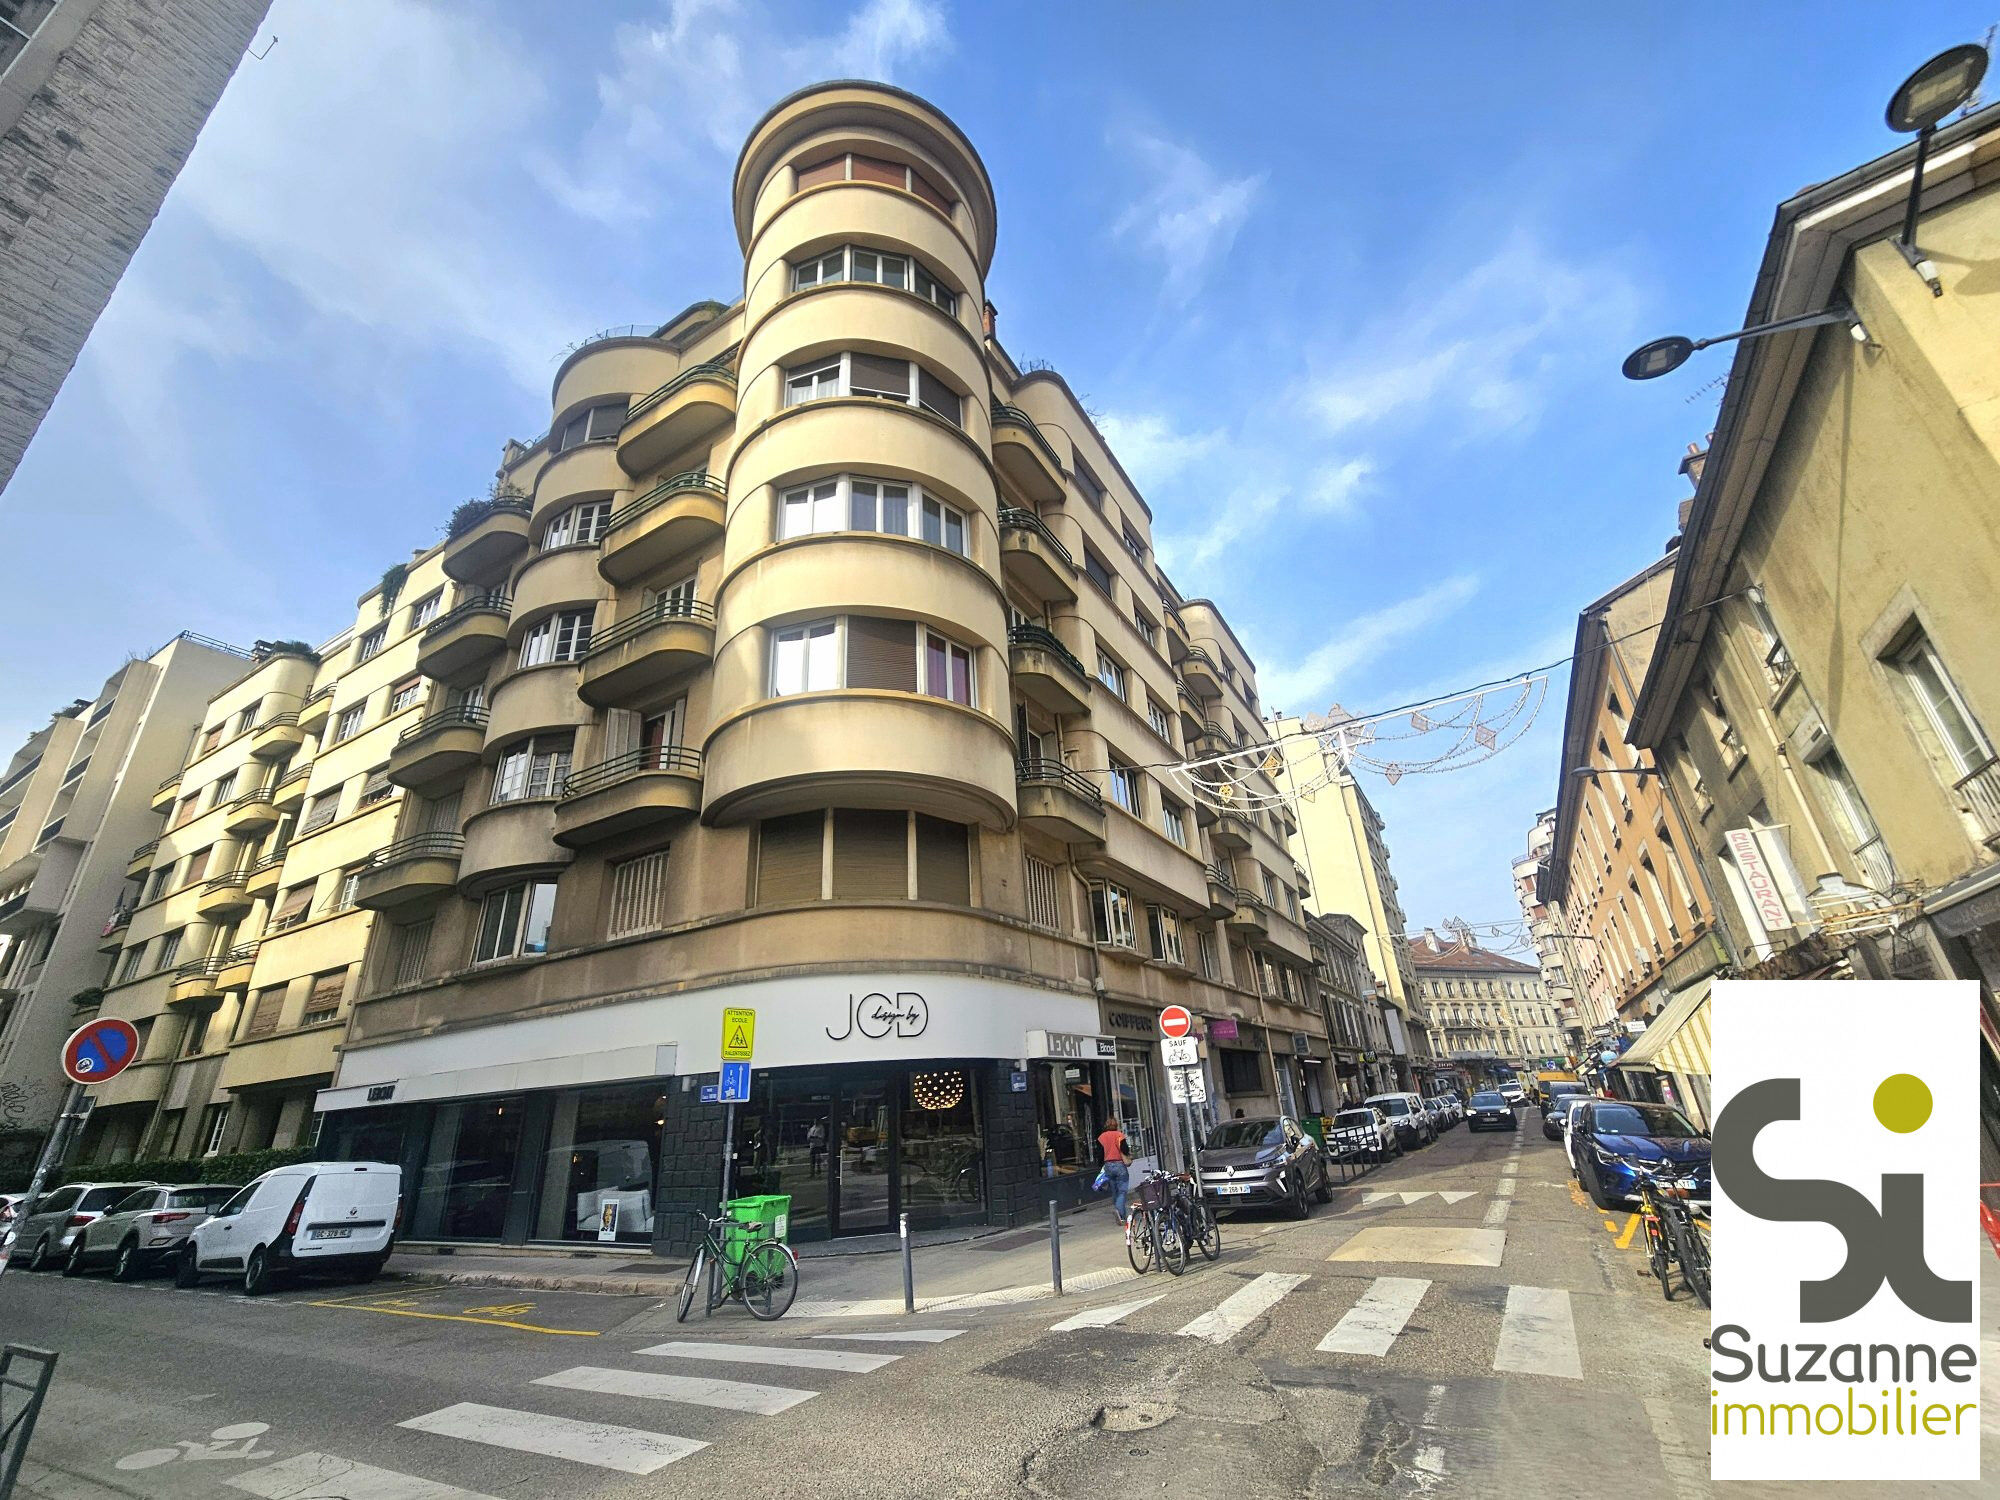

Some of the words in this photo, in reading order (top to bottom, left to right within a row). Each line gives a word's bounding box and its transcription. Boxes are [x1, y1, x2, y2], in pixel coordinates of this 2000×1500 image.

[1731, 832, 1784, 928] RESTAURANT
[871, 1005, 905, 1025] design
[905, 1005, 920, 1025] by
[1108, 1011, 1153, 1032] COIFFEUR
[1047, 1034, 1082, 1058] LEICHT
[1168, 1039, 1187, 1048] SAUF
